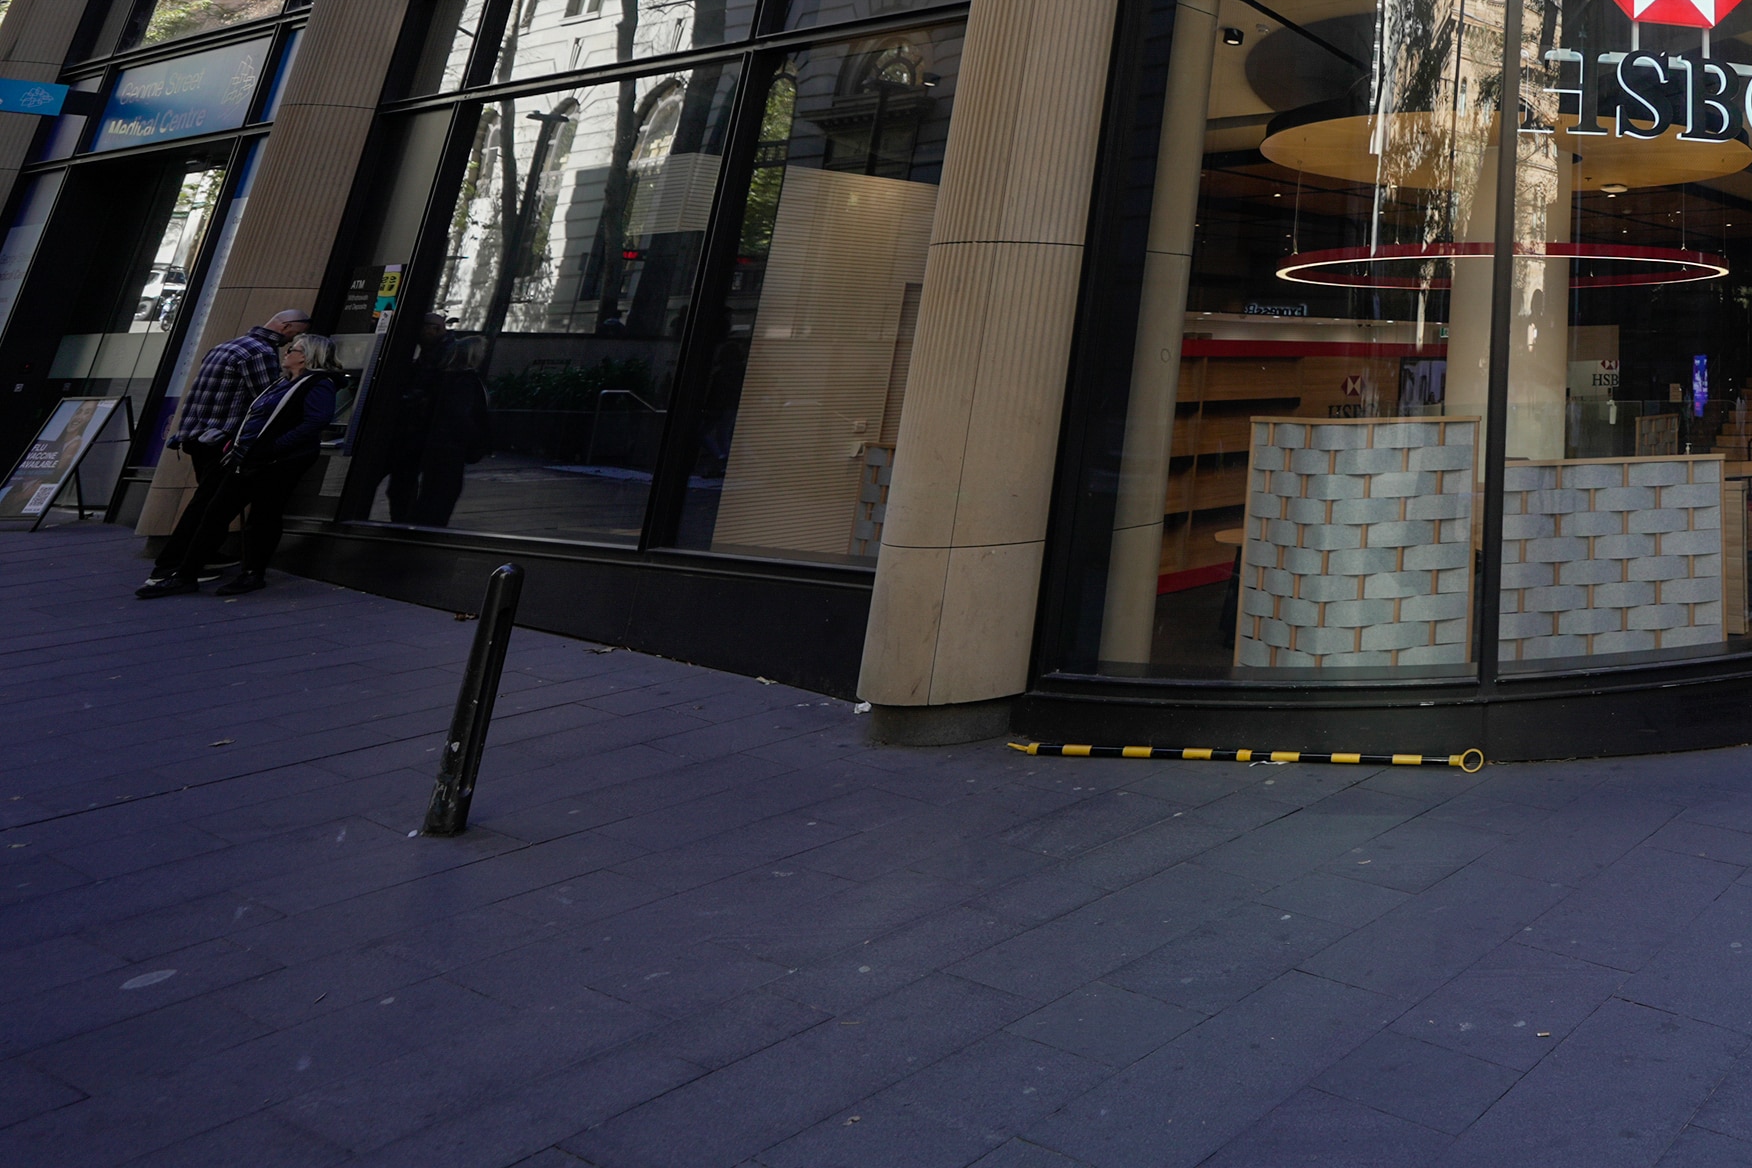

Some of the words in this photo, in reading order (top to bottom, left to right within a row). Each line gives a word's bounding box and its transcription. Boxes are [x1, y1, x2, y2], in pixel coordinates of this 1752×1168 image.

[119, 79, 165, 106] George
[165, 67, 206, 97] Street
[106, 116, 157, 138] Medical
[158, 107, 208, 134] Centre
[350, 279, 366, 290] ATM
[32, 444, 48, 452] FLU
[26, 452, 59, 460] VACCINE
[18, 460, 59, 469] AVAILABLE
